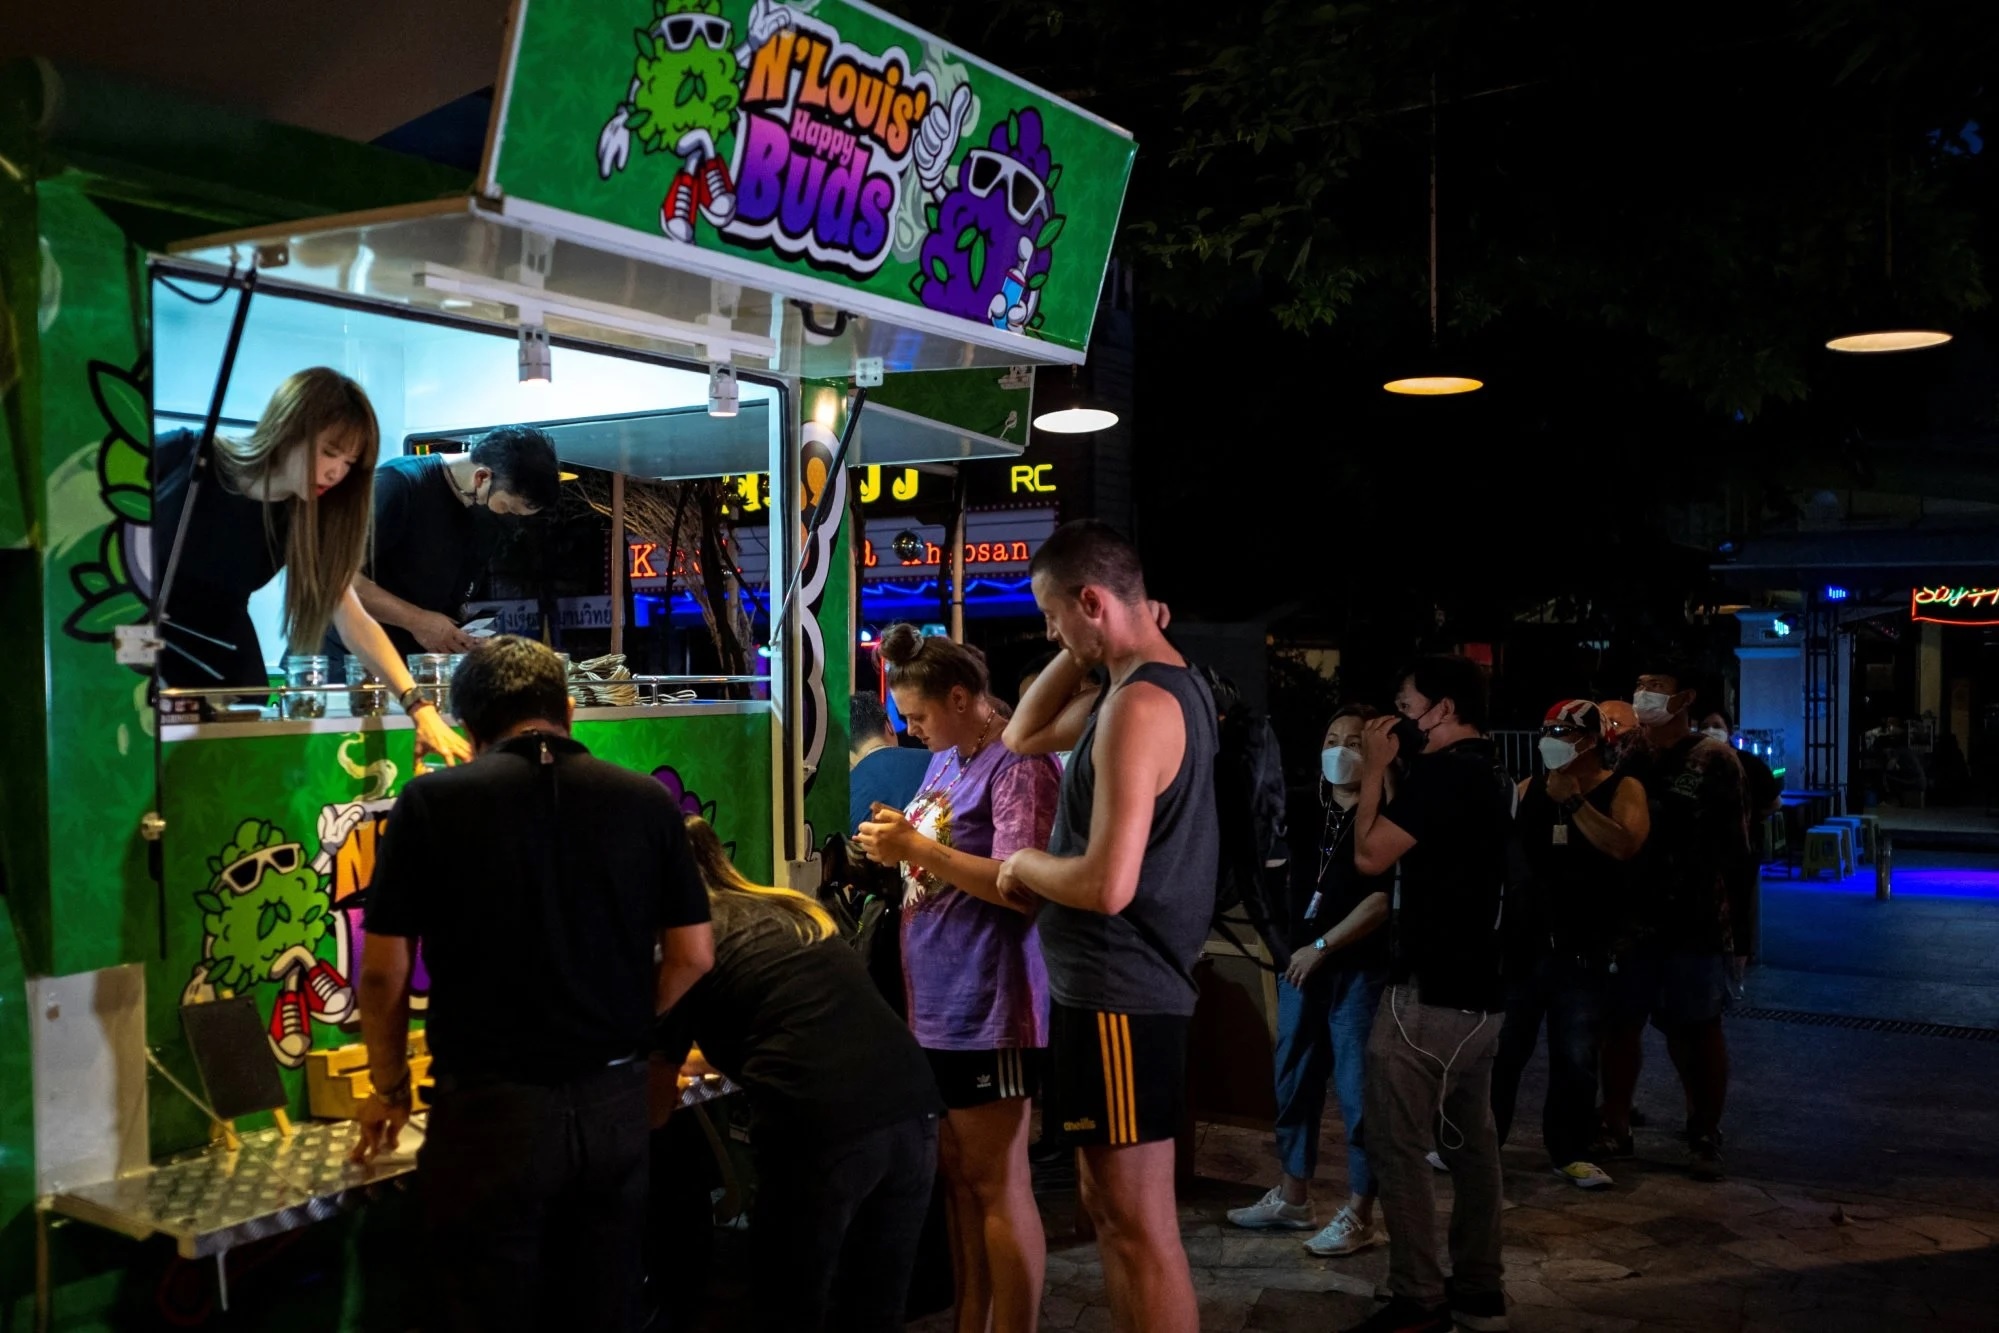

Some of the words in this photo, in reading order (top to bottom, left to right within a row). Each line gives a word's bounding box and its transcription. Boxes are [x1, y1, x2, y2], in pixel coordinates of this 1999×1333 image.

[789, 108, 857, 166] Happy
[735, 113, 892, 255] Buds
[1011, 464, 1057, 493] RC
[902, 540, 1031, 566] hosan
